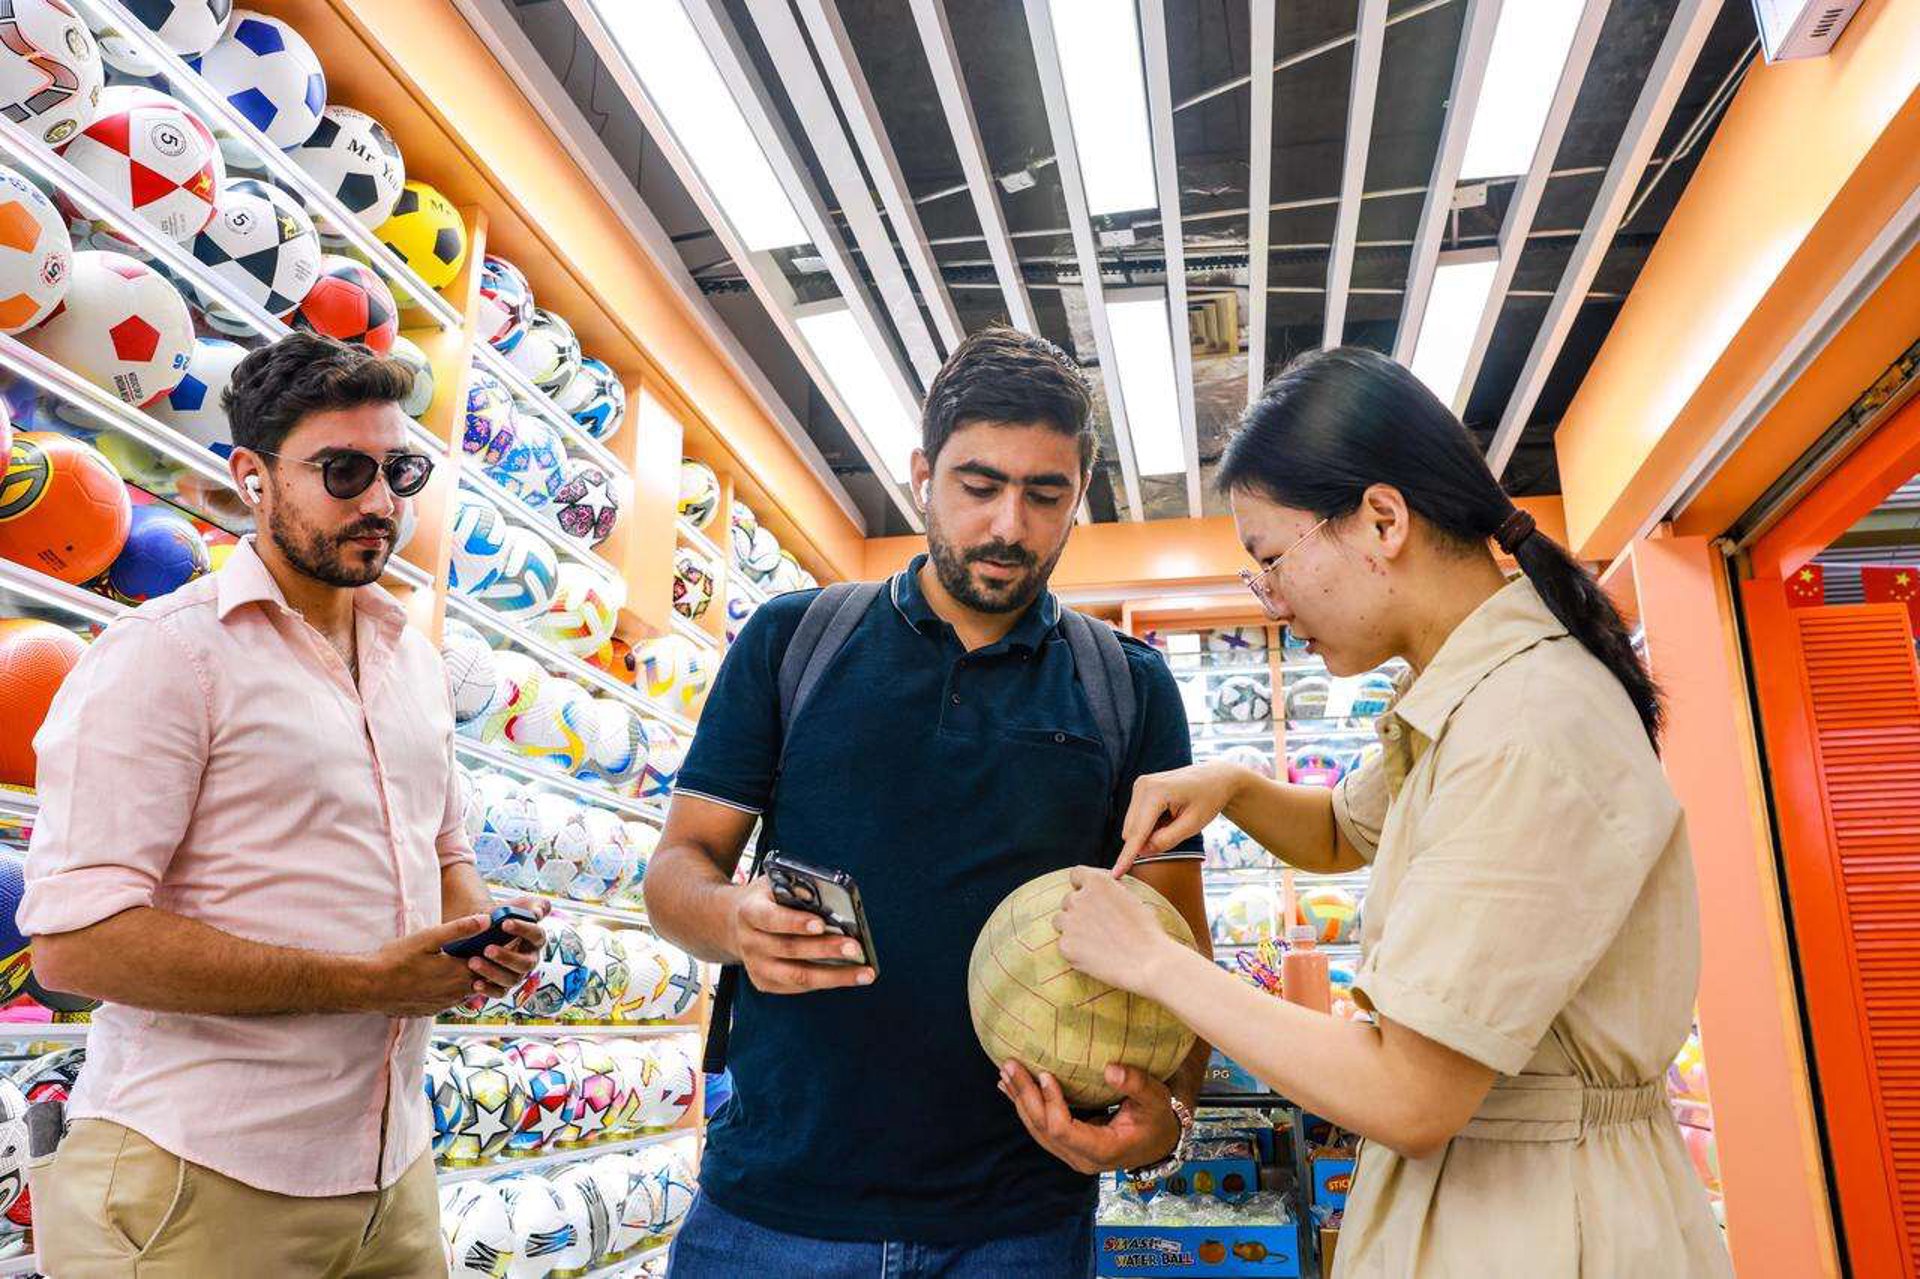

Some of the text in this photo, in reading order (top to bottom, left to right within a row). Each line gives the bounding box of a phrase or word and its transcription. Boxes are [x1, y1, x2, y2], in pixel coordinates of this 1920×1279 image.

[347, 139, 375, 162] Mr
[1328, 1180, 1348, 1190] STIC
[1115, 1252, 1194, 1268] WATER BALL
